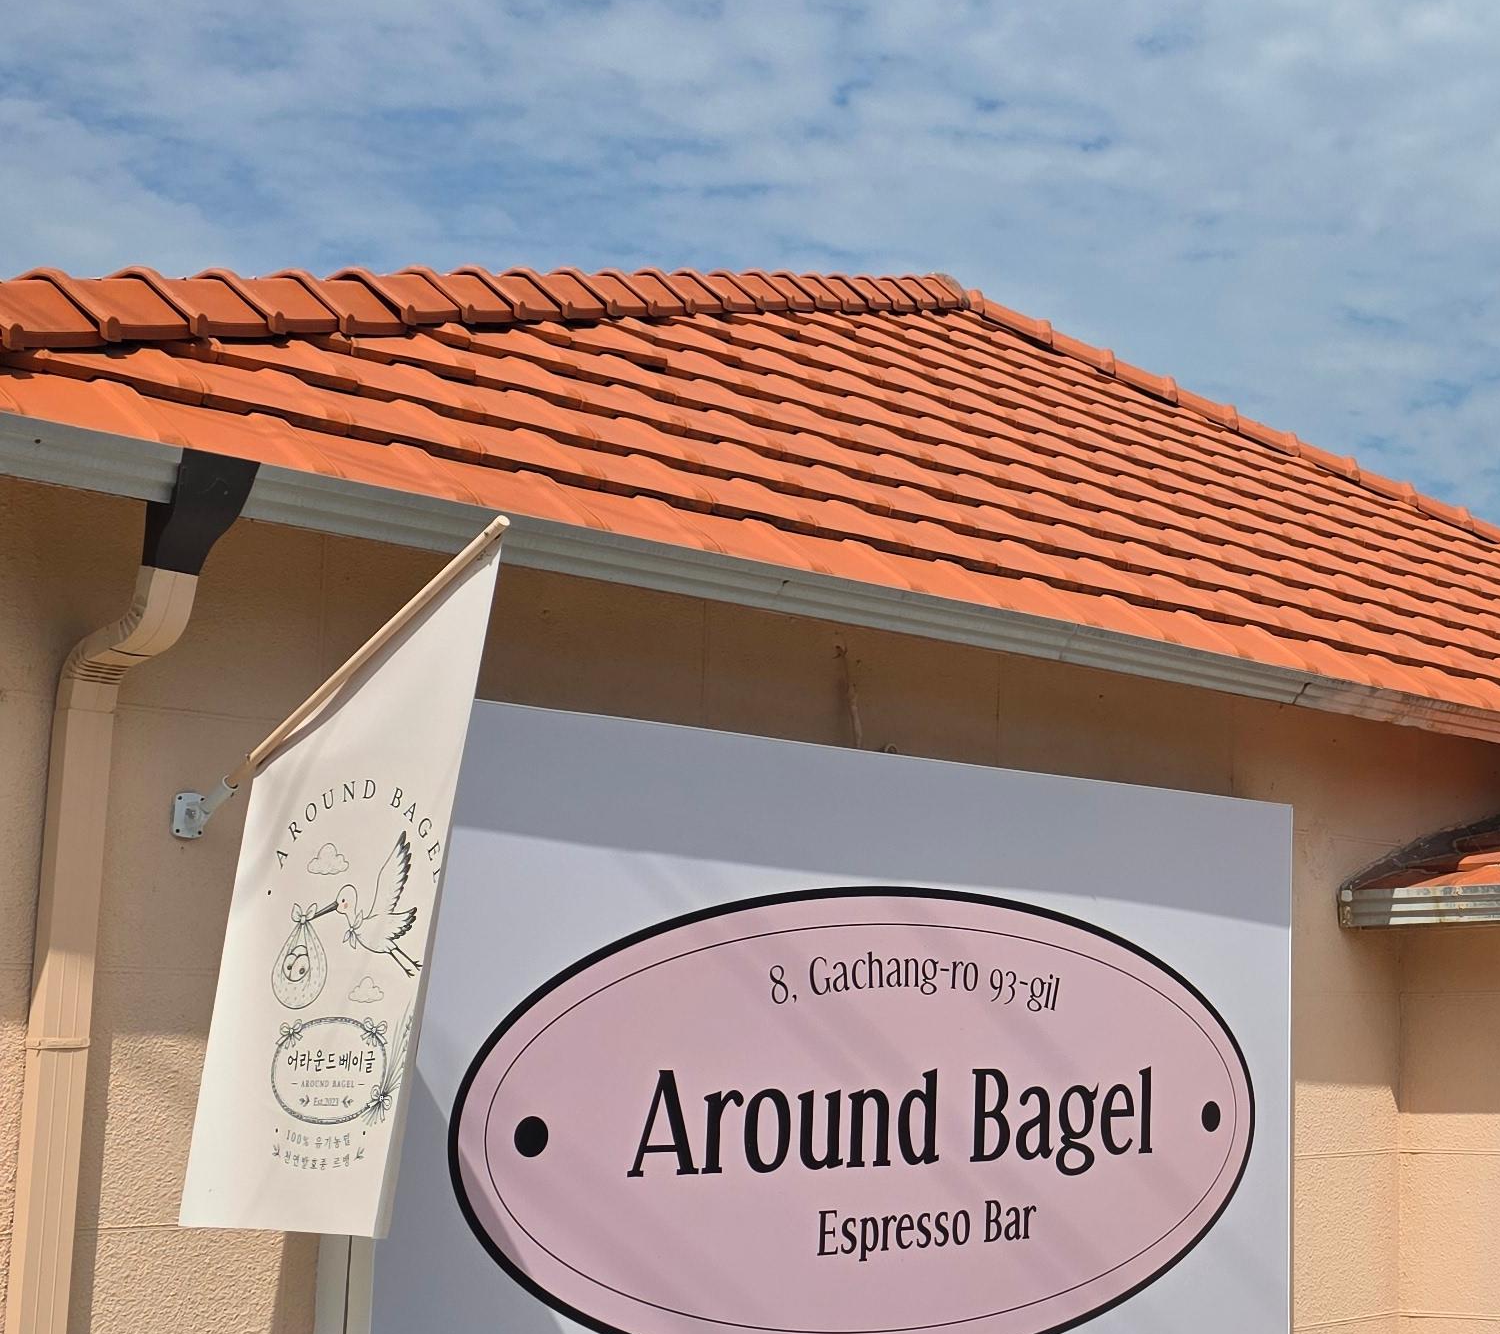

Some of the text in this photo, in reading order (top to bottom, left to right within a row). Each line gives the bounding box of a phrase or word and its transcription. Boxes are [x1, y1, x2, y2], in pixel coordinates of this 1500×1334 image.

[276, 779, 376, 869] AROUND
[770, 952, 1059, 1011] 8, Gachang-ro 93-gil
[288, 1050, 375, 1073] 어라운드베이글
[301, 1079, 355, 1088] AROUND BAGEL
[627, 1066, 1152, 1177] Around Bagel
[817, 1200, 1036, 1261] Espresso Bar
